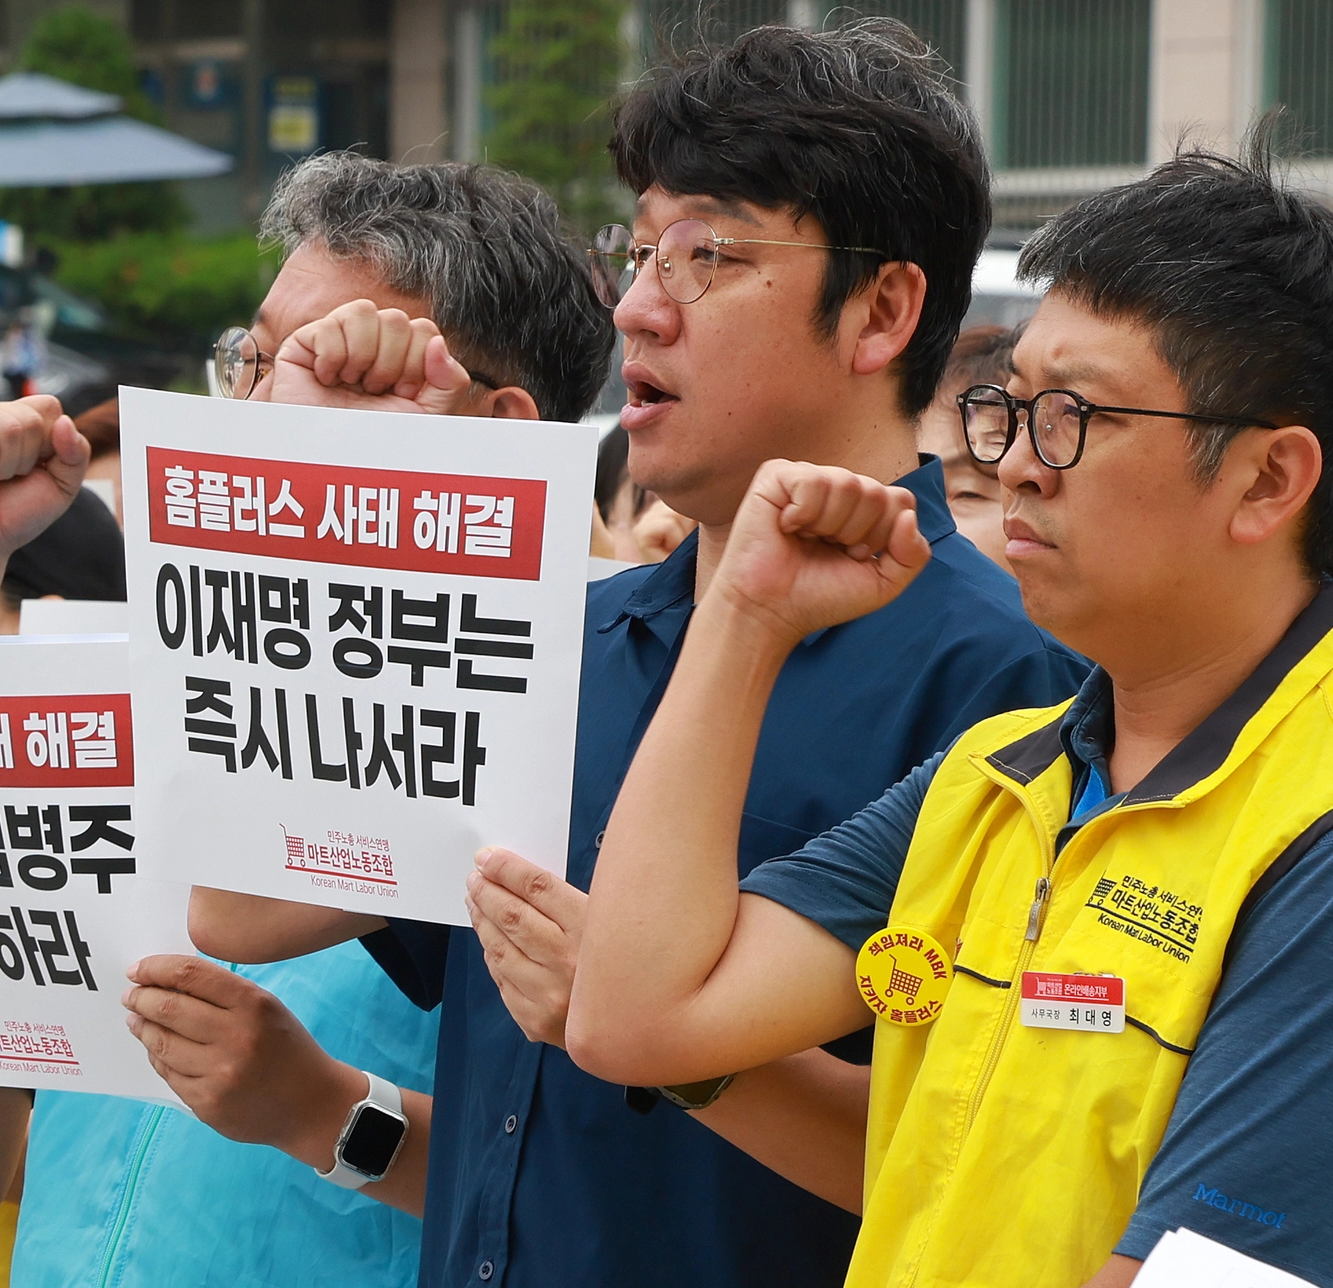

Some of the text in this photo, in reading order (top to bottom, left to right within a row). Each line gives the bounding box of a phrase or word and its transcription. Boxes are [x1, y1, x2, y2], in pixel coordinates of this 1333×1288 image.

[163, 465, 516, 558] 홈플러스 사태 해결
[155, 562, 534, 695] 이재명 정부는
[23, 710, 118, 769] 해결
[183, 675, 488, 807] 즉시 나서라
[307, 843, 393, 876] 마트산업노동조합
[327, 830, 390, 852] 민주노총 서비스연맹
[310, 875, 399, 898] Korean Mart Labor Union
[1121, 875, 1159, 899] 민주노총
[868, 933, 948, 980] 책임져라 MBK
[1097, 913, 1125, 932] Korean
[1138, 930, 1164, 948] Labor
[1162, 942, 1191, 965] Union
[859, 975, 943, 1023] 지키자 홈플러스
[1064, 983, 1108, 998] 온라인배송지부
[4, 1020, 66, 1036] 민주노총 서비스연맹
[1031, 1008, 1061, 1020] 사무국장
[23, 1062, 41, 1073] Mart
[41, 1064, 60, 1074] Labor
[61, 1066, 83, 1076] Union
[1192, 1182, 1287, 1229] Marmot
